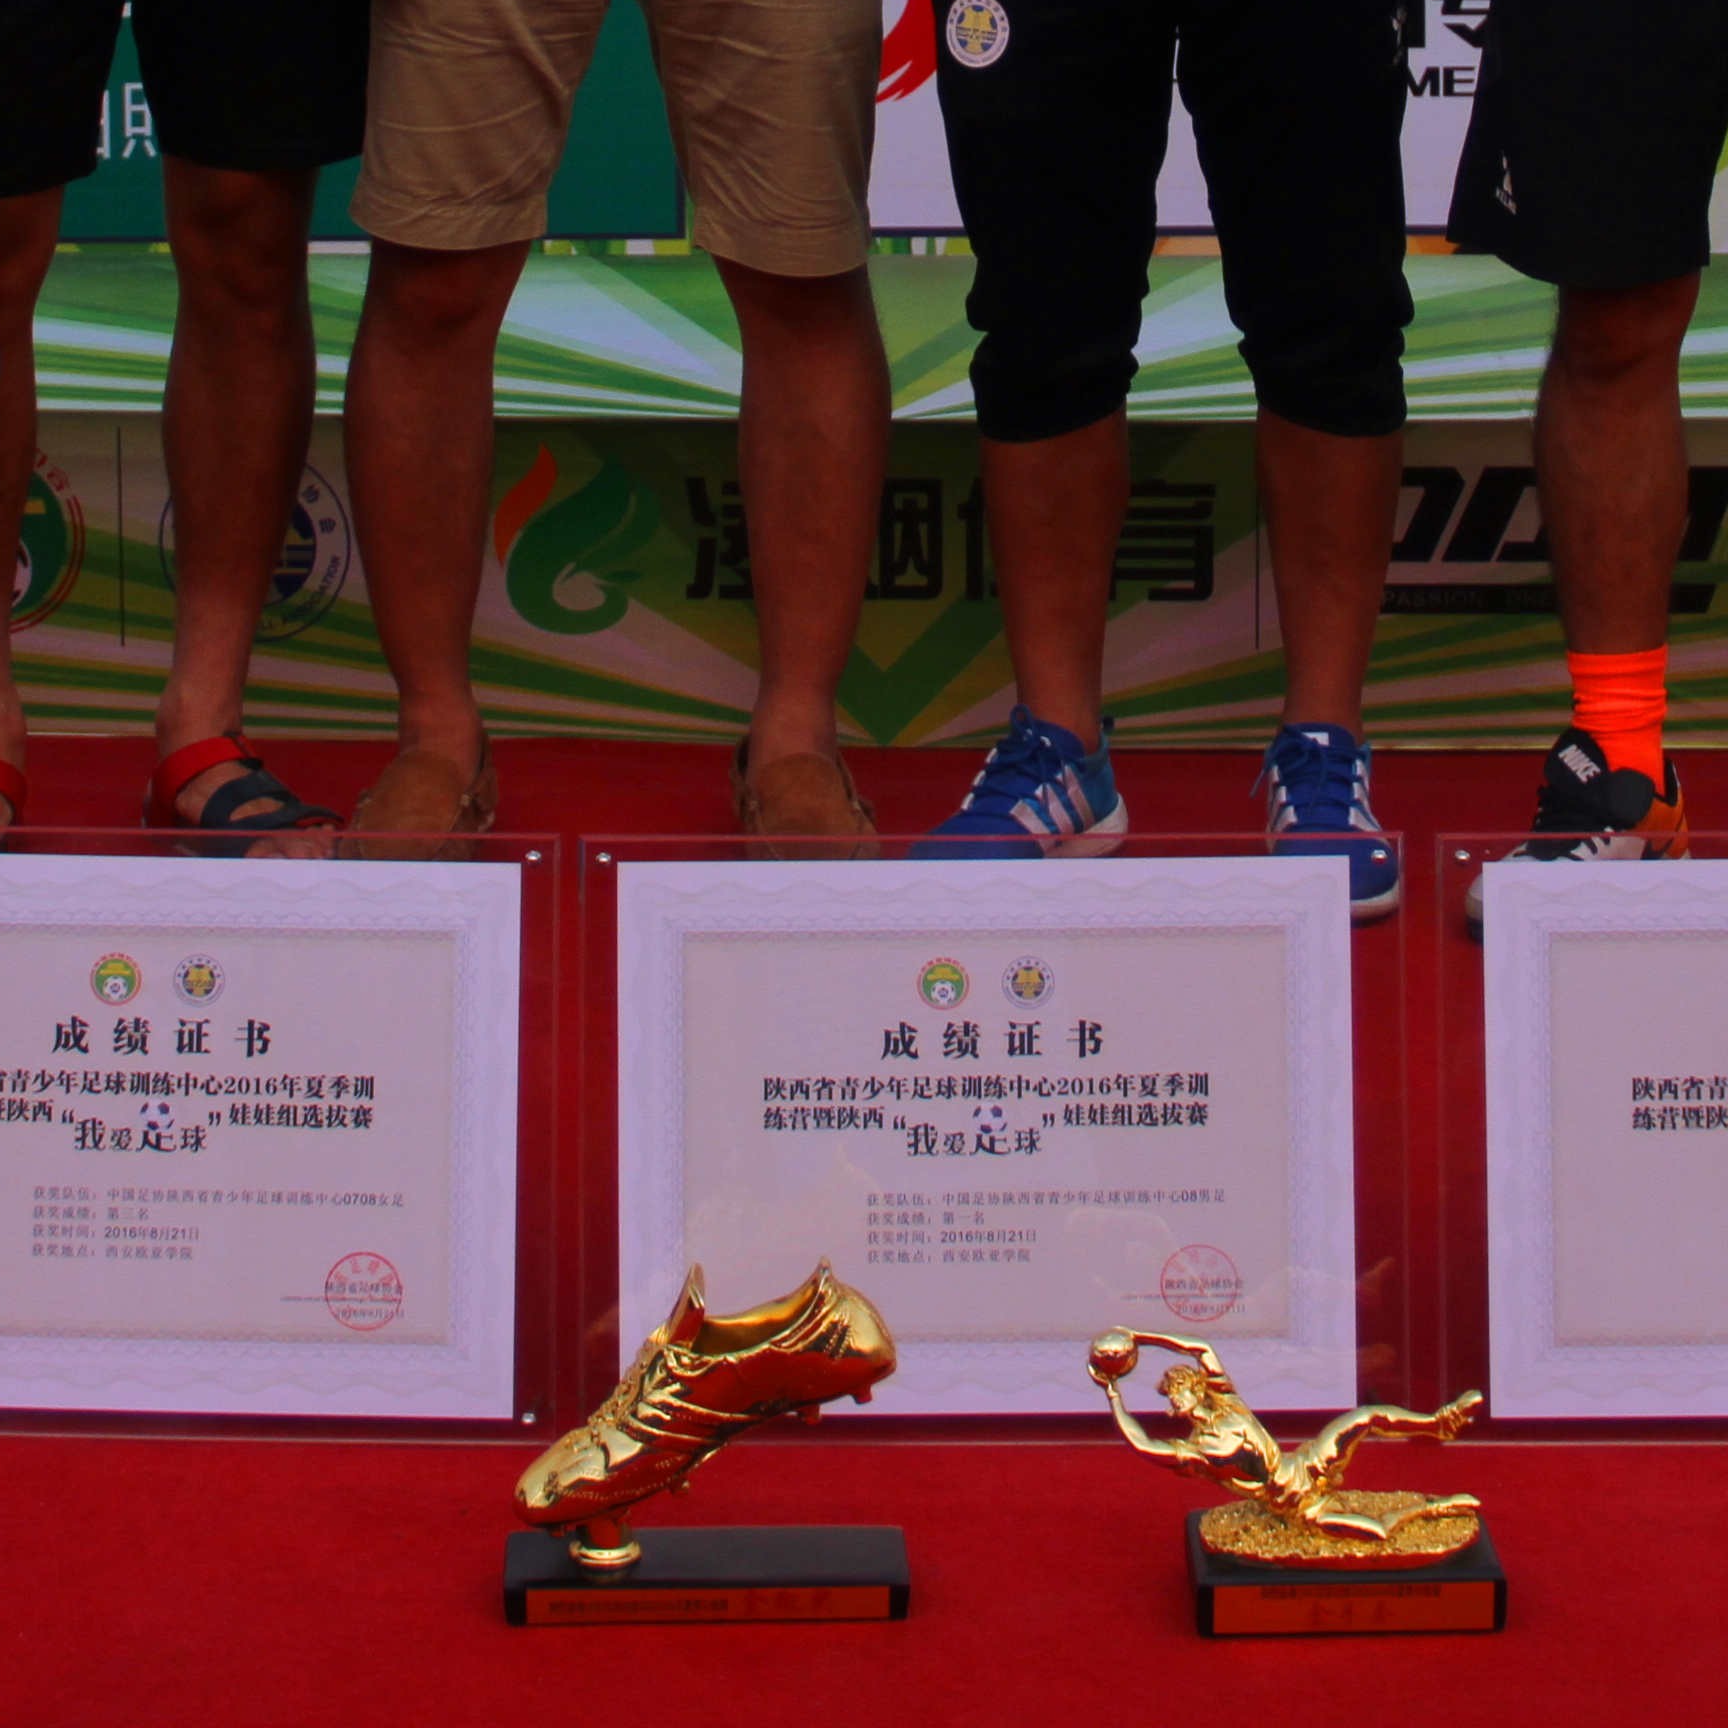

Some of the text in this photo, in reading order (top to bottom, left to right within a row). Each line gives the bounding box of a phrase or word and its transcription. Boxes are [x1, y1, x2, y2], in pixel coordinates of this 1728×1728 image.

[1556, 743, 1602, 785] NIKE
[52, 1015, 273, 1058] 成绩证书
[880, 1019, 1104, 1061] 成绩证书
[762, 1072, 1210, 1103] 陕西省青少年足球训练中心2016年夏季训
